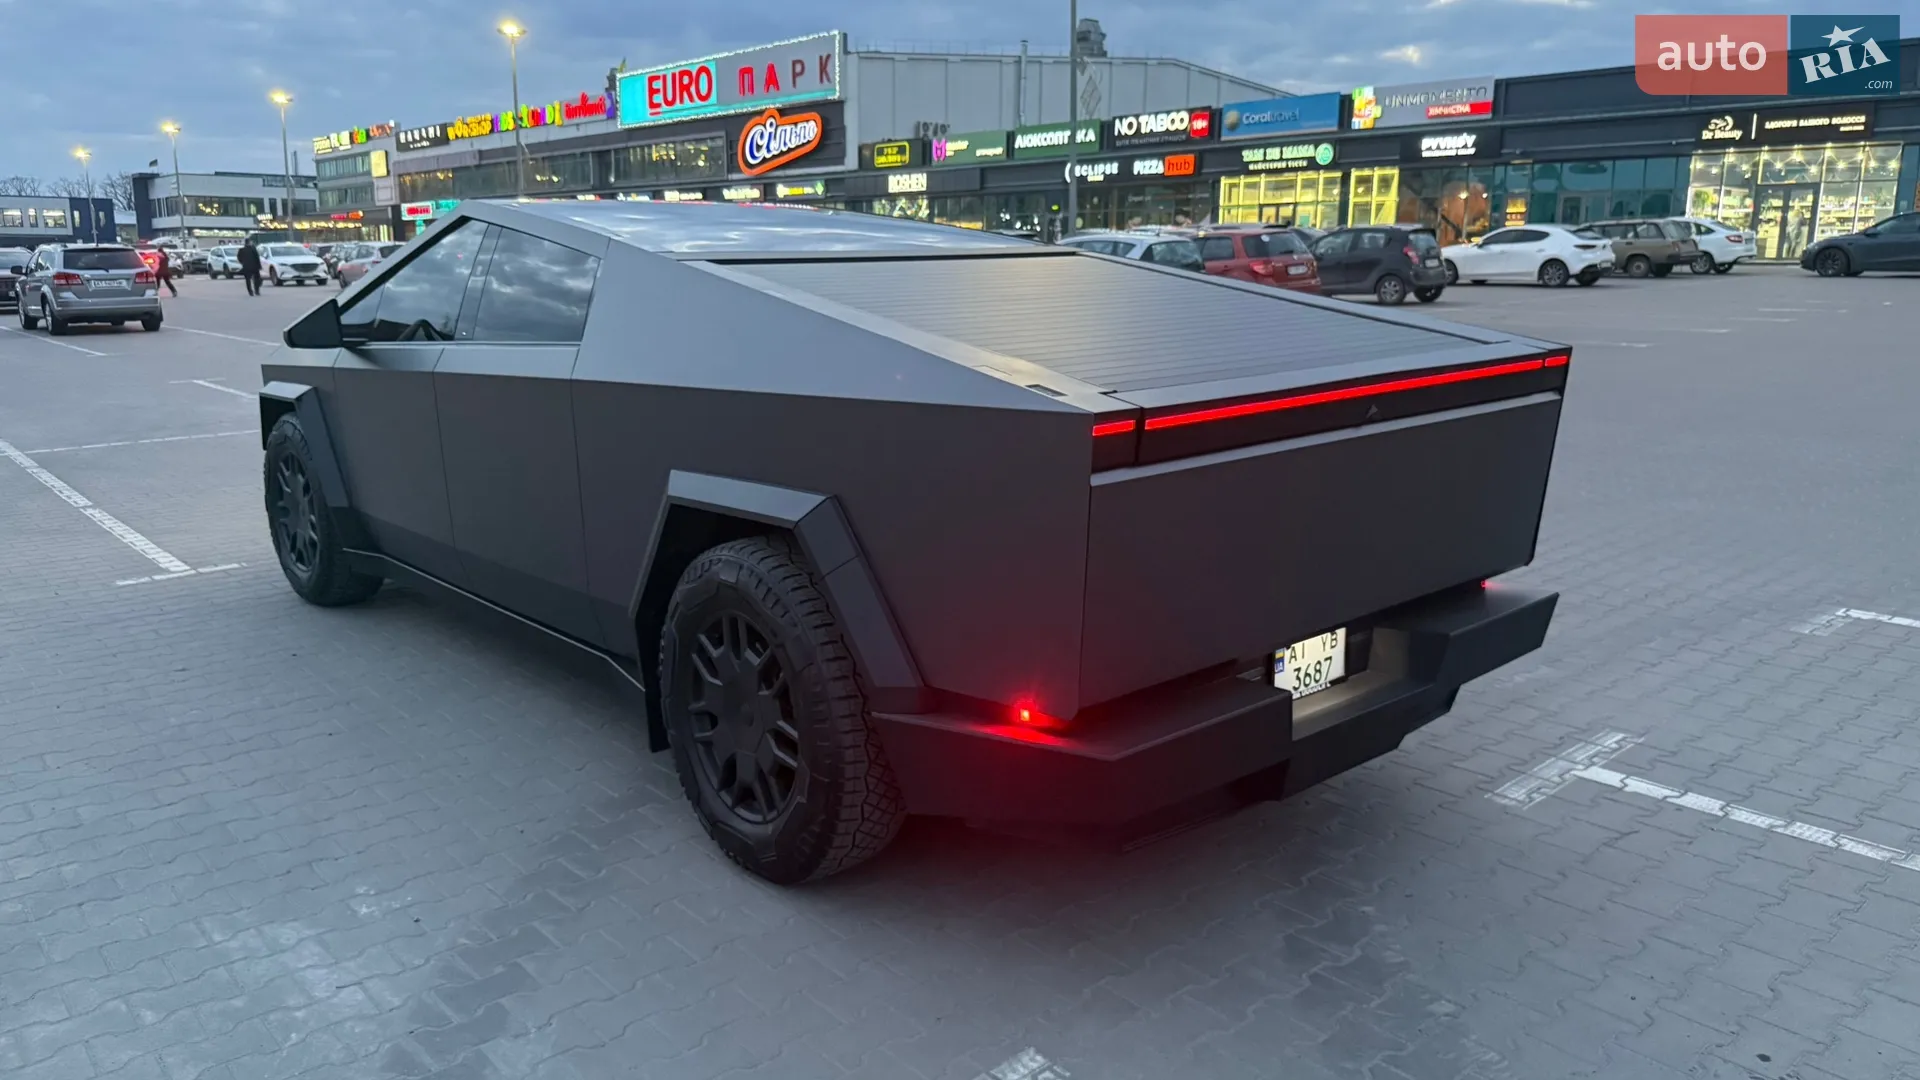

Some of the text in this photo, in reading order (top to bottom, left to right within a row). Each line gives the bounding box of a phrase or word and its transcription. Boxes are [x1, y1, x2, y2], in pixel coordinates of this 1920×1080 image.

[647, 65, 714, 109] EURO
[737, 53, 832, 97] ПАРК
[1114, 111, 1189, 136] NO TABOO
[1191, 119, 1208, 130] 18+
[745, 117, 818, 164] Сільпо
[1014, 128, 1096, 149] ЛЮКСОПТКА
[1714, 129, 1743, 141] Beauty
[1075, 161, 1119, 177] ECLIPSE
[1132, 157, 1191, 175] PIZZA hub
[888, 173, 927, 193] ROSHEN
[1288, 642, 1306, 664] AI
[1275, 661, 1285, 673] UA
[1292, 656, 1333, 692] 3687
